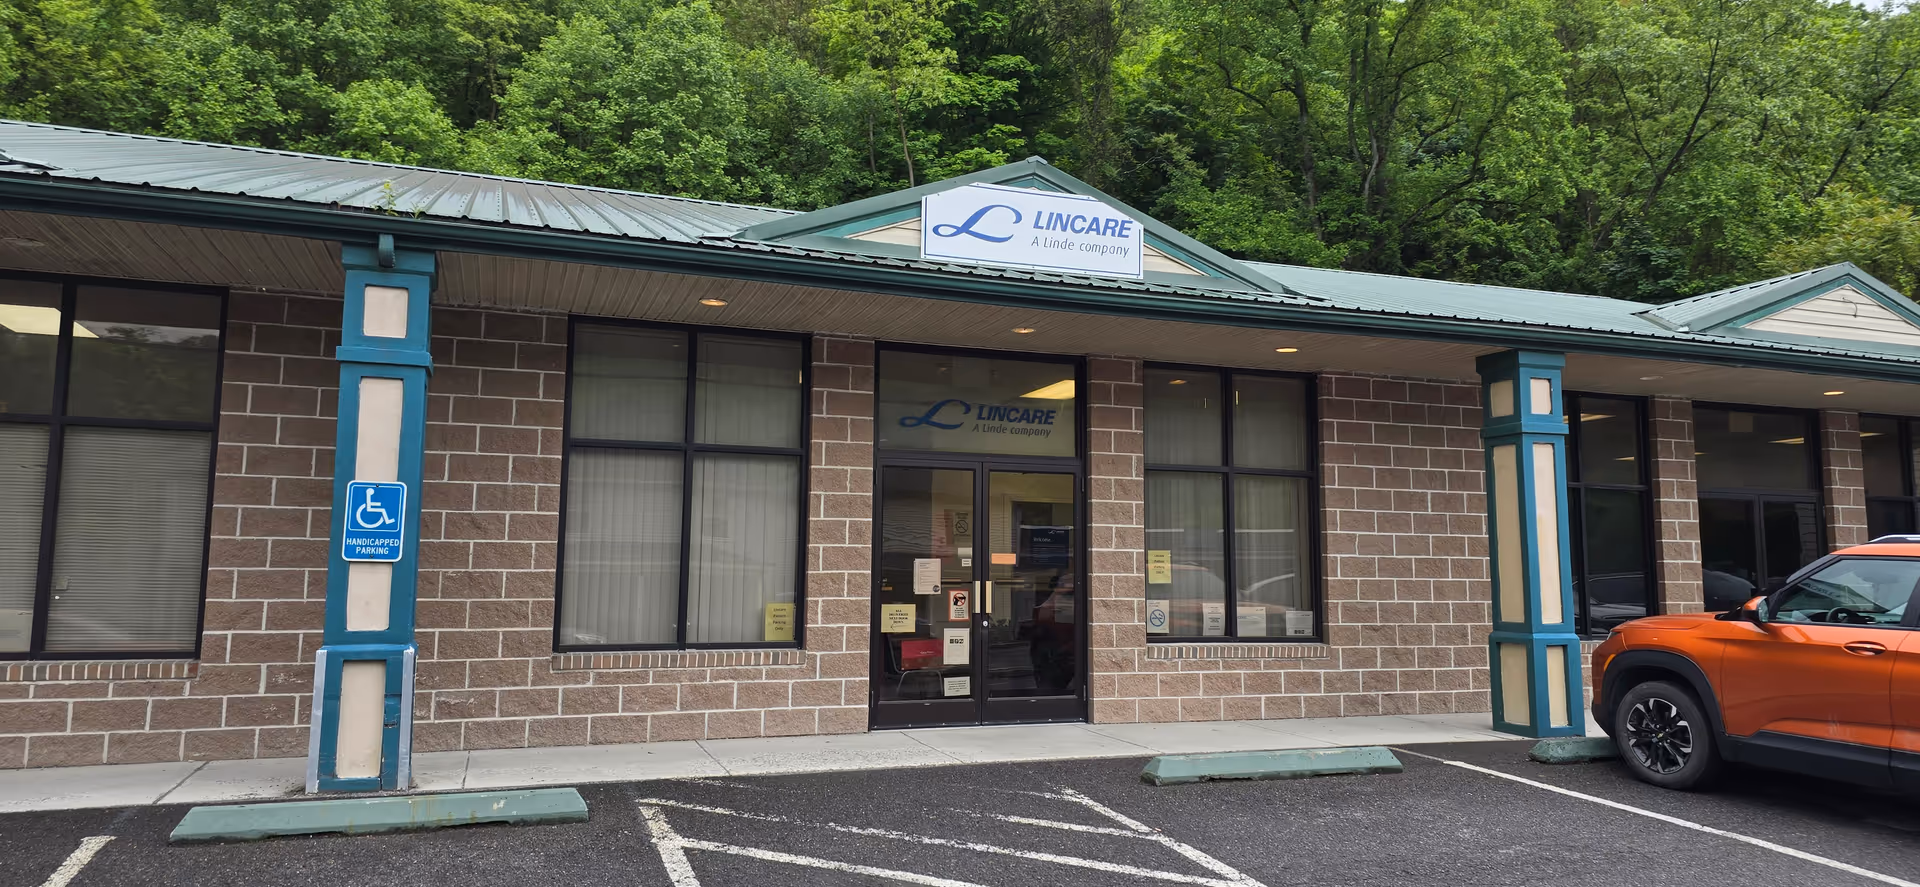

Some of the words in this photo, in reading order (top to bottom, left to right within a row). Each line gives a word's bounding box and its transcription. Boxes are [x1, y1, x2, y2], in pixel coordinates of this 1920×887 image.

[1033, 210, 1133, 239] LINCARE
[1031, 236, 1039, 247] A
[1043, 237, 1075, 251] Linde
[1079, 242, 1130, 257] company
[976, 405, 1056, 426] LINCARE
[972, 423, 979, 432] A
[982, 423, 1007, 434] Linde
[1010, 426, 1051, 438] company
[346, 538, 400, 546] HANDICAPPED
